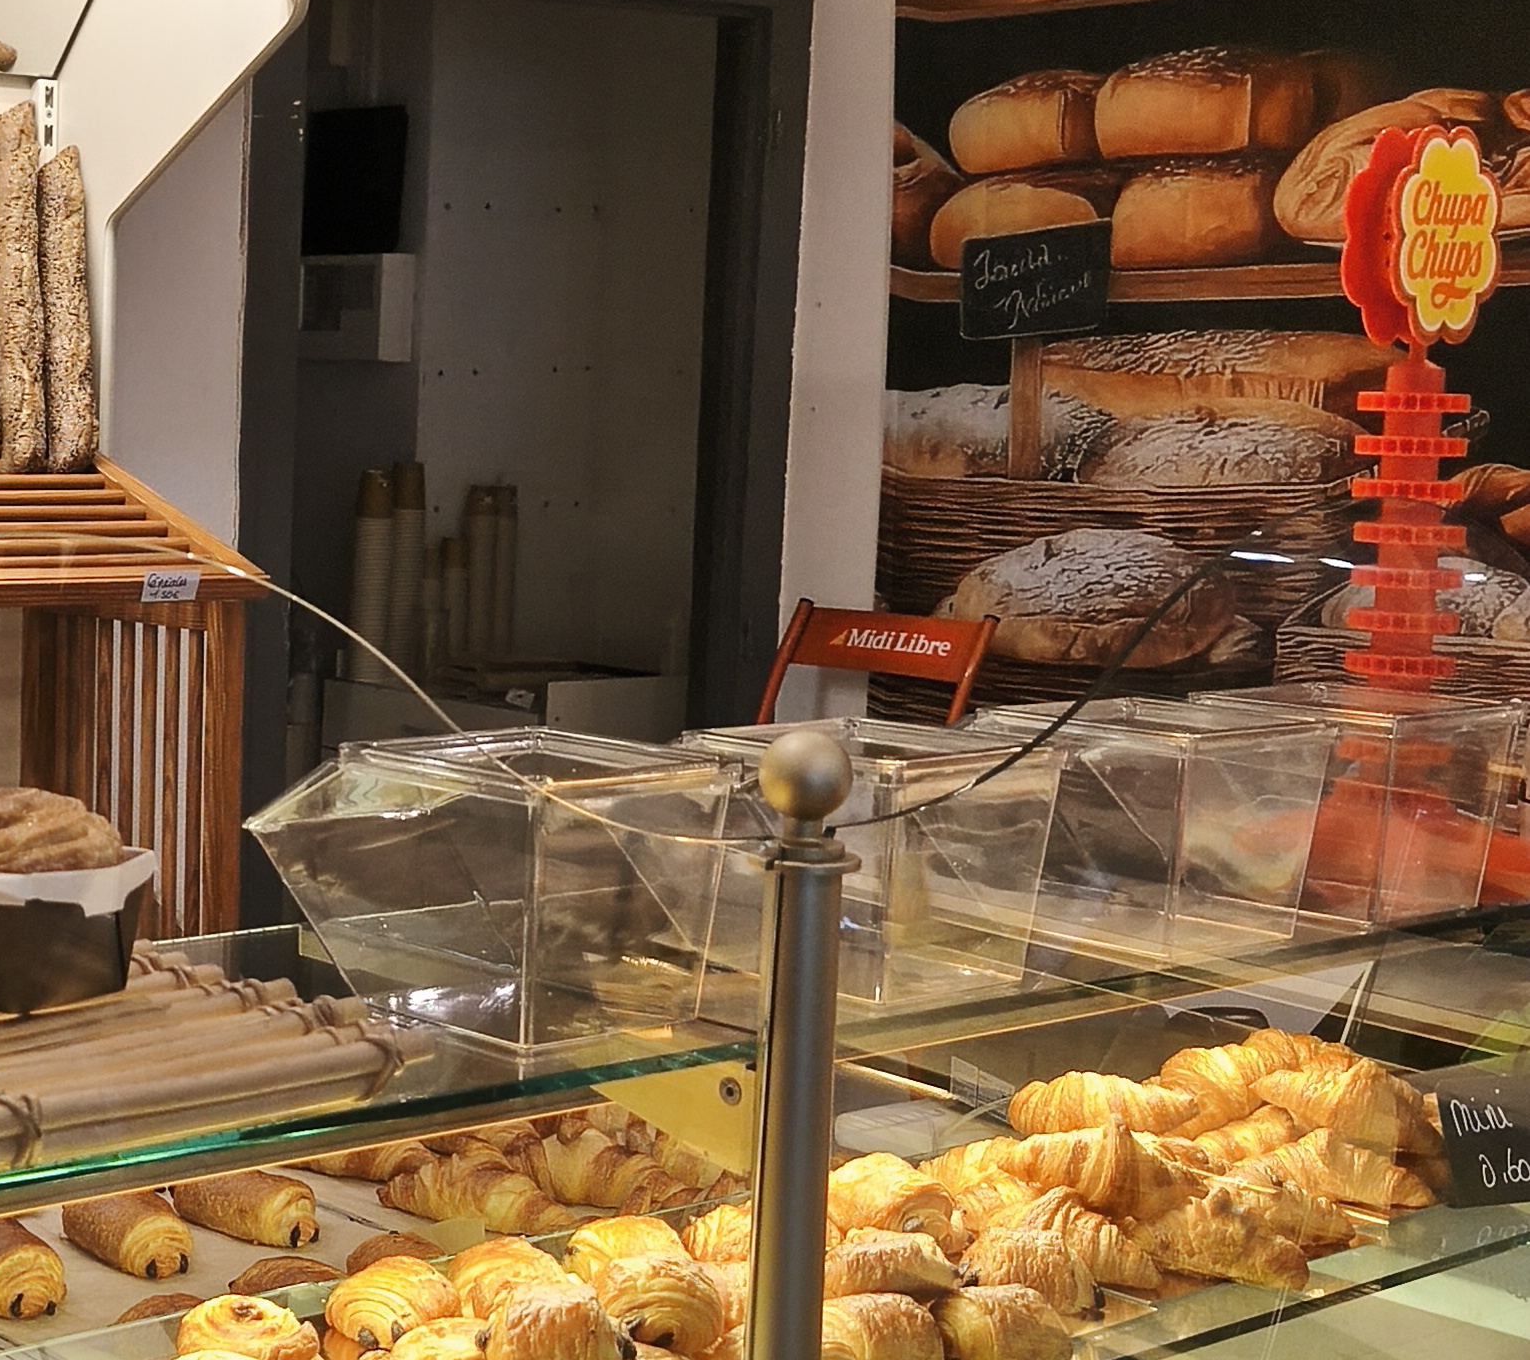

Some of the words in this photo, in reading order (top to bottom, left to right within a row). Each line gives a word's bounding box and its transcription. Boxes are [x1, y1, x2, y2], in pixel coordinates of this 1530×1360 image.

[1412, 180, 1489, 239] Chupa
[1406, 228, 1484, 310] Chups
[847, 628, 896, 650] Midi
[893, 632, 952, 656] Libre
